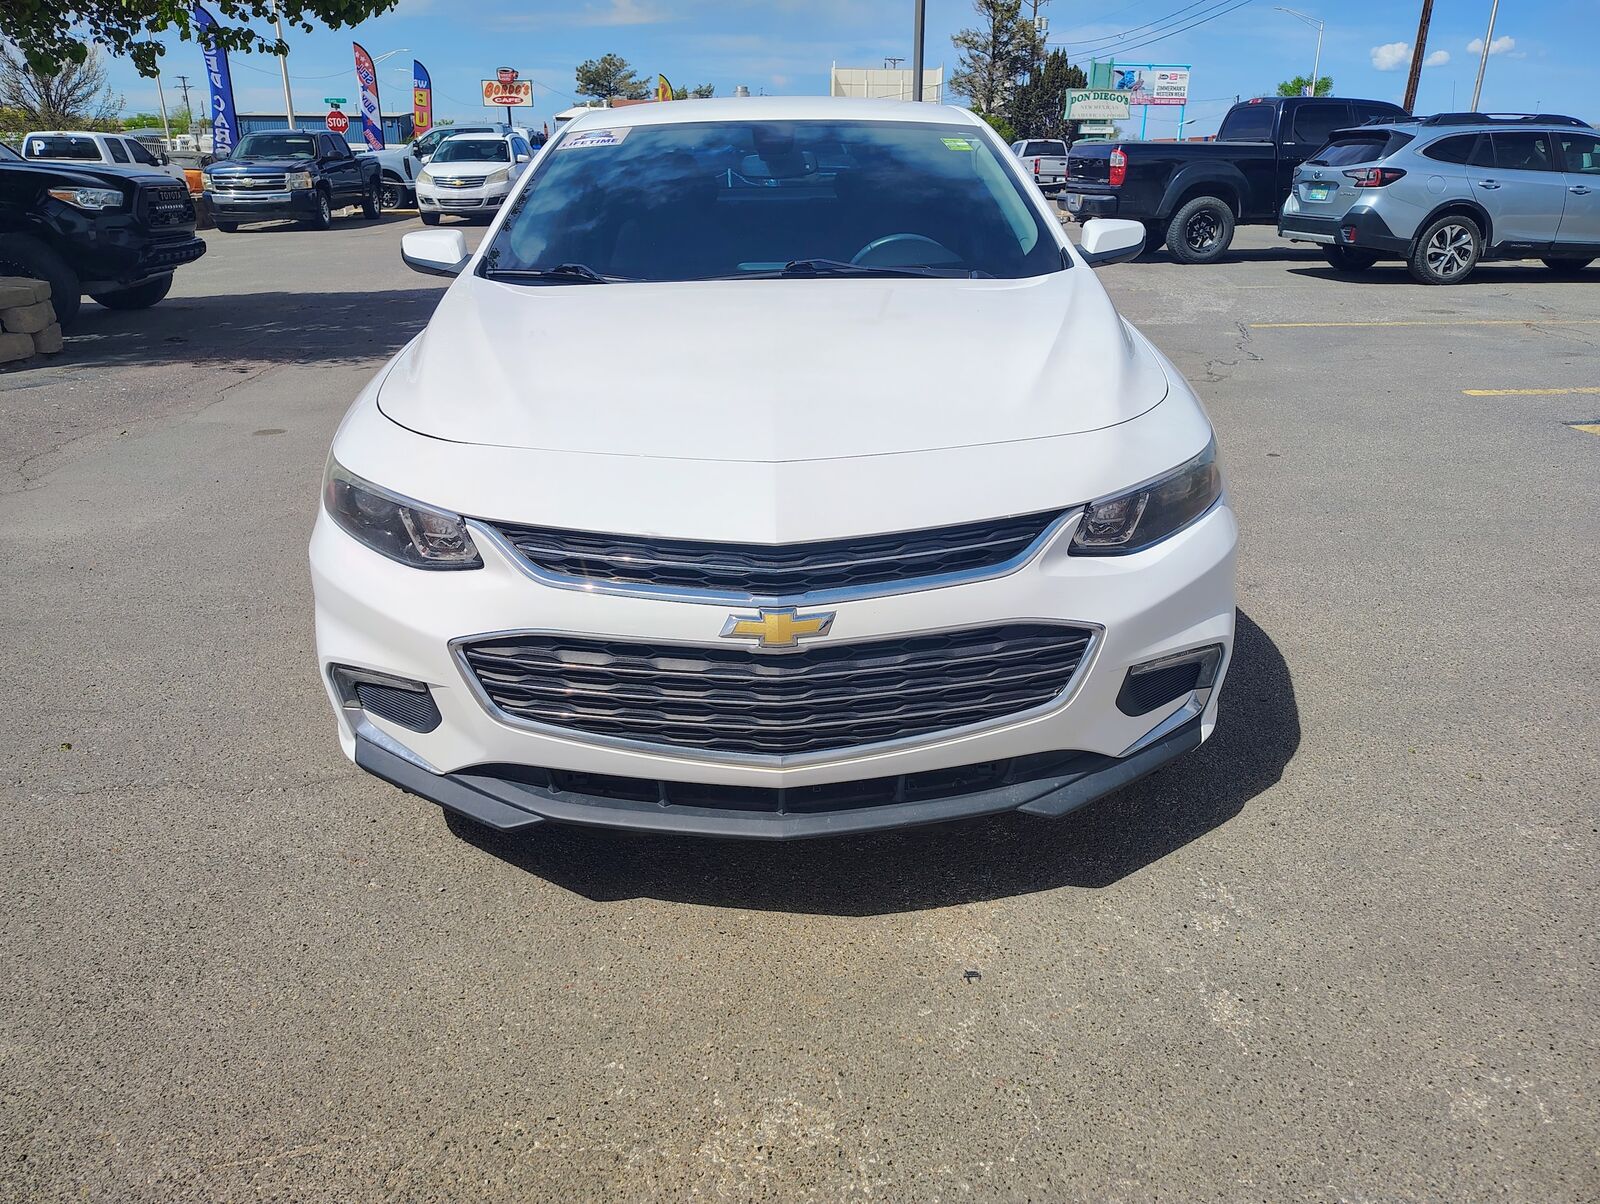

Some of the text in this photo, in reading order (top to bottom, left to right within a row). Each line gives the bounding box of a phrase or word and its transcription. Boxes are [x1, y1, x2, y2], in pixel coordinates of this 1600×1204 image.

[1071, 92, 1129, 105] DON DIEGO'S
[327, 117, 347, 128] STOP
[32, 140, 46, 156] P
[562, 138, 619, 148] LIFETIME
[160, 191, 182, 200] TOYOTA
